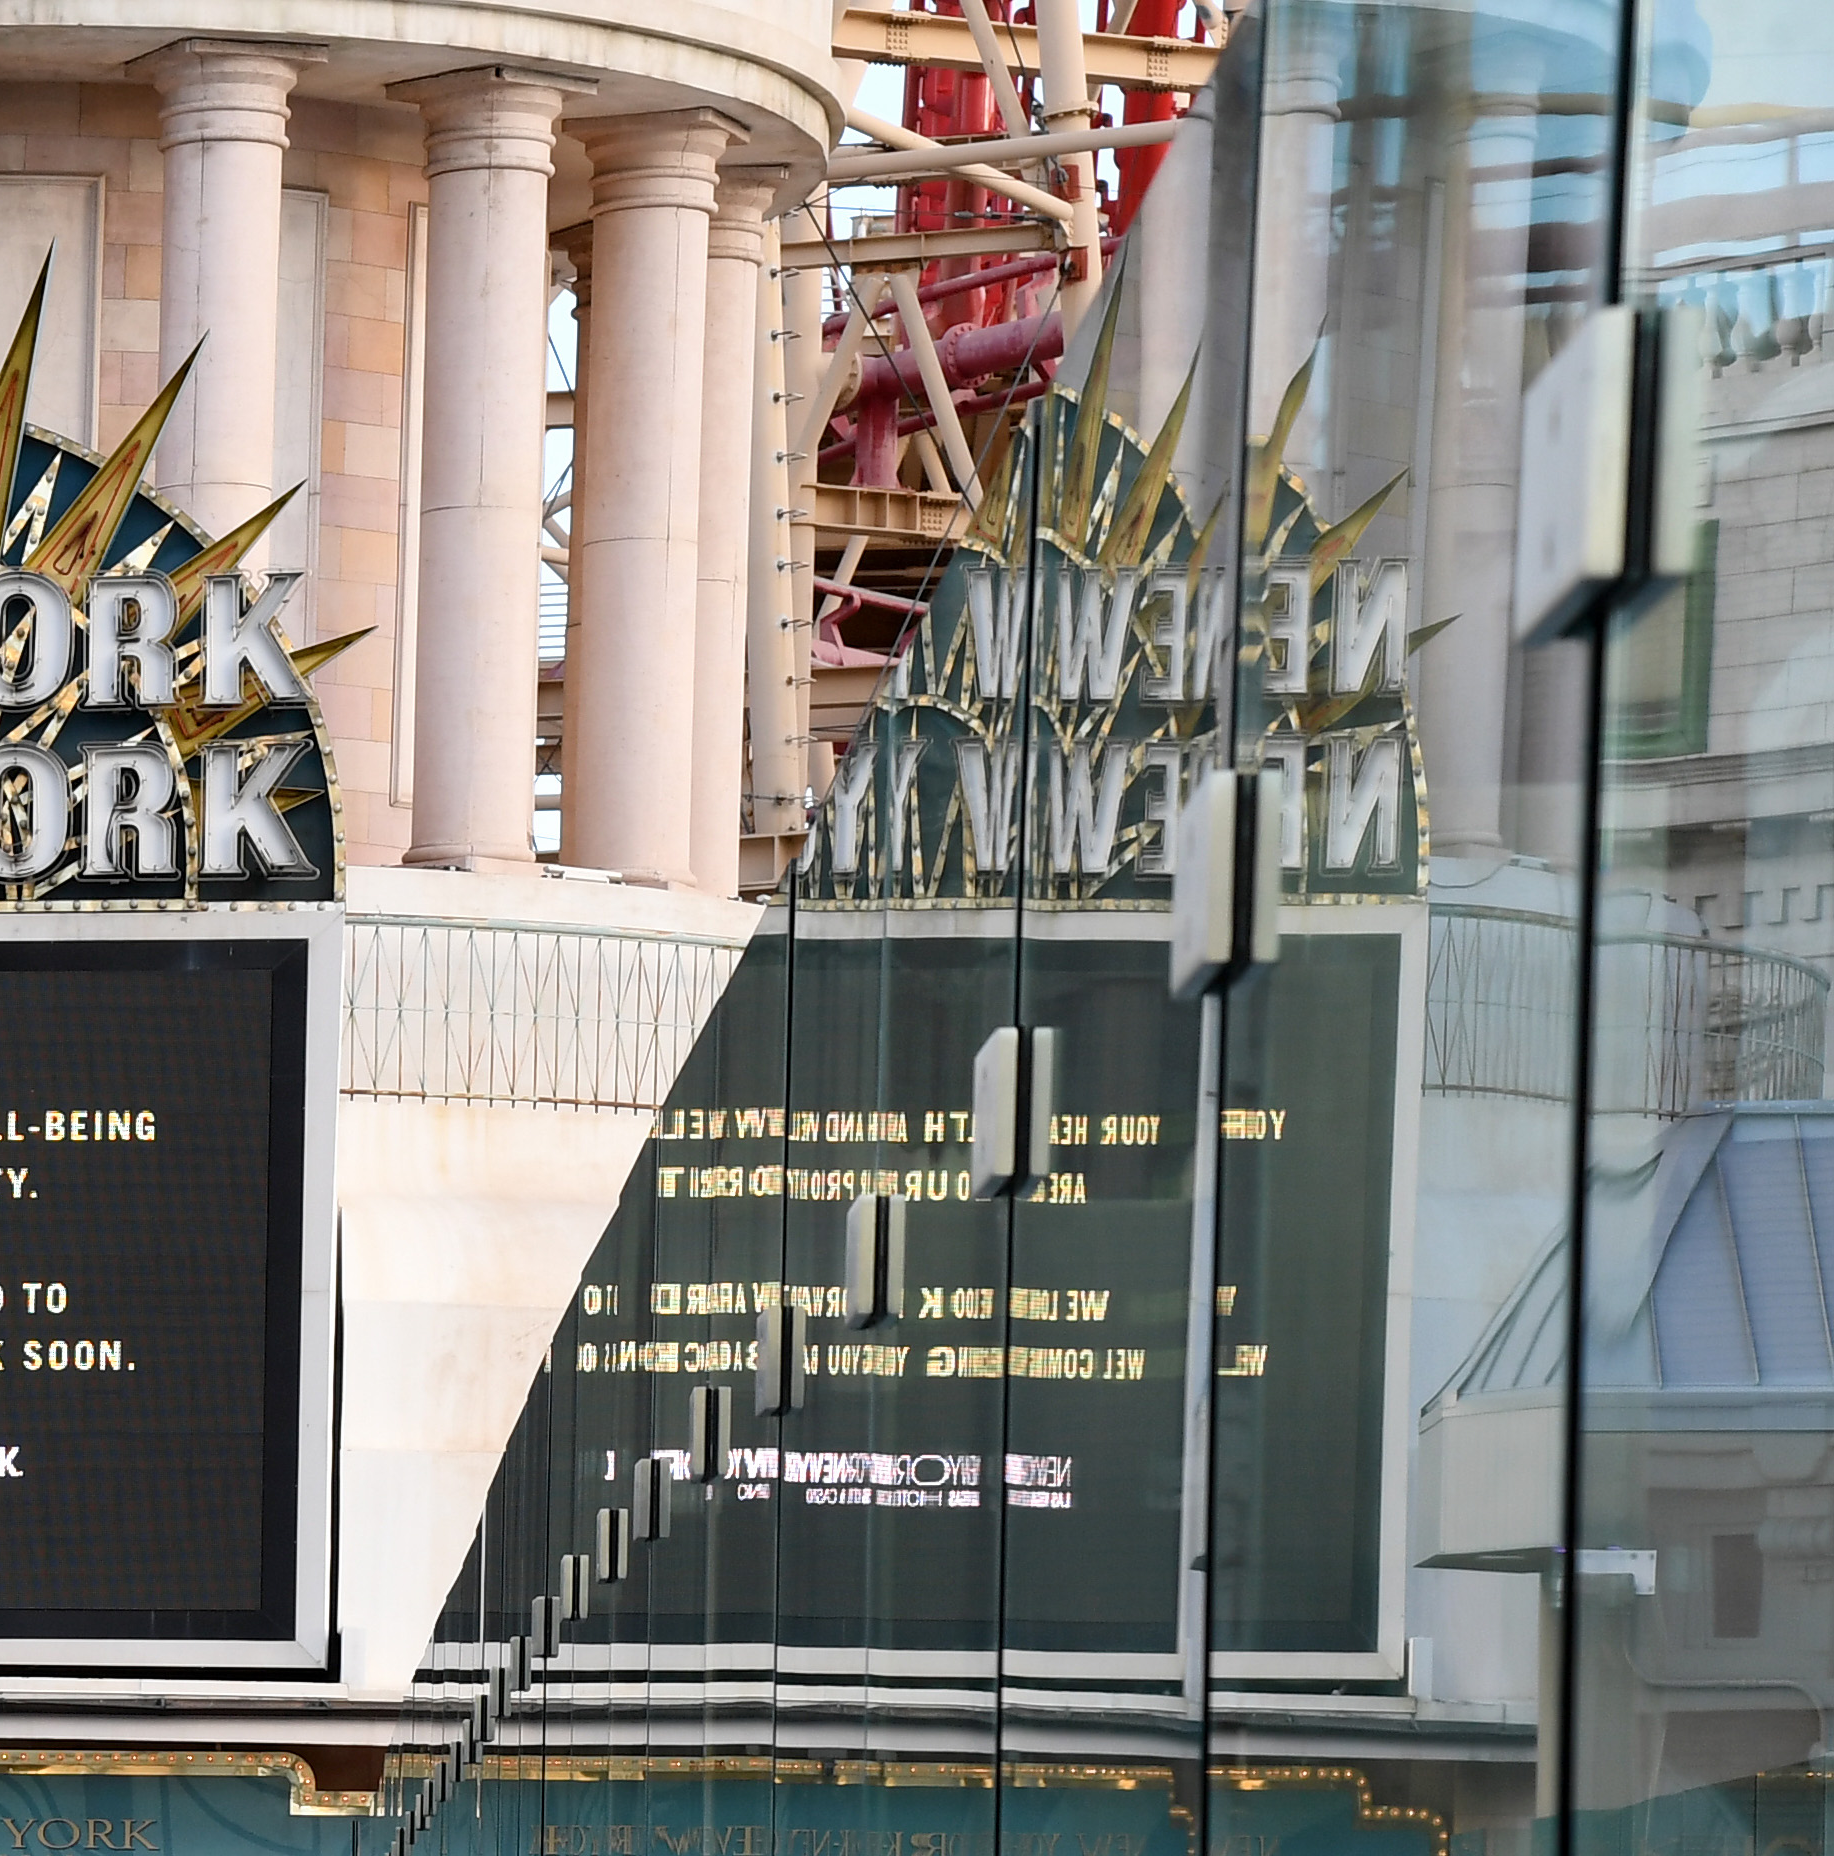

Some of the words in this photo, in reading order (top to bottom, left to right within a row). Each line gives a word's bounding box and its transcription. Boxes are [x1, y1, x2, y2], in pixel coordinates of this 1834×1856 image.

[21, 1281, 69, 1315] TO
[21, 1339, 136, 1372] SOON.
[0, 1817, 161, 1851] YORK
